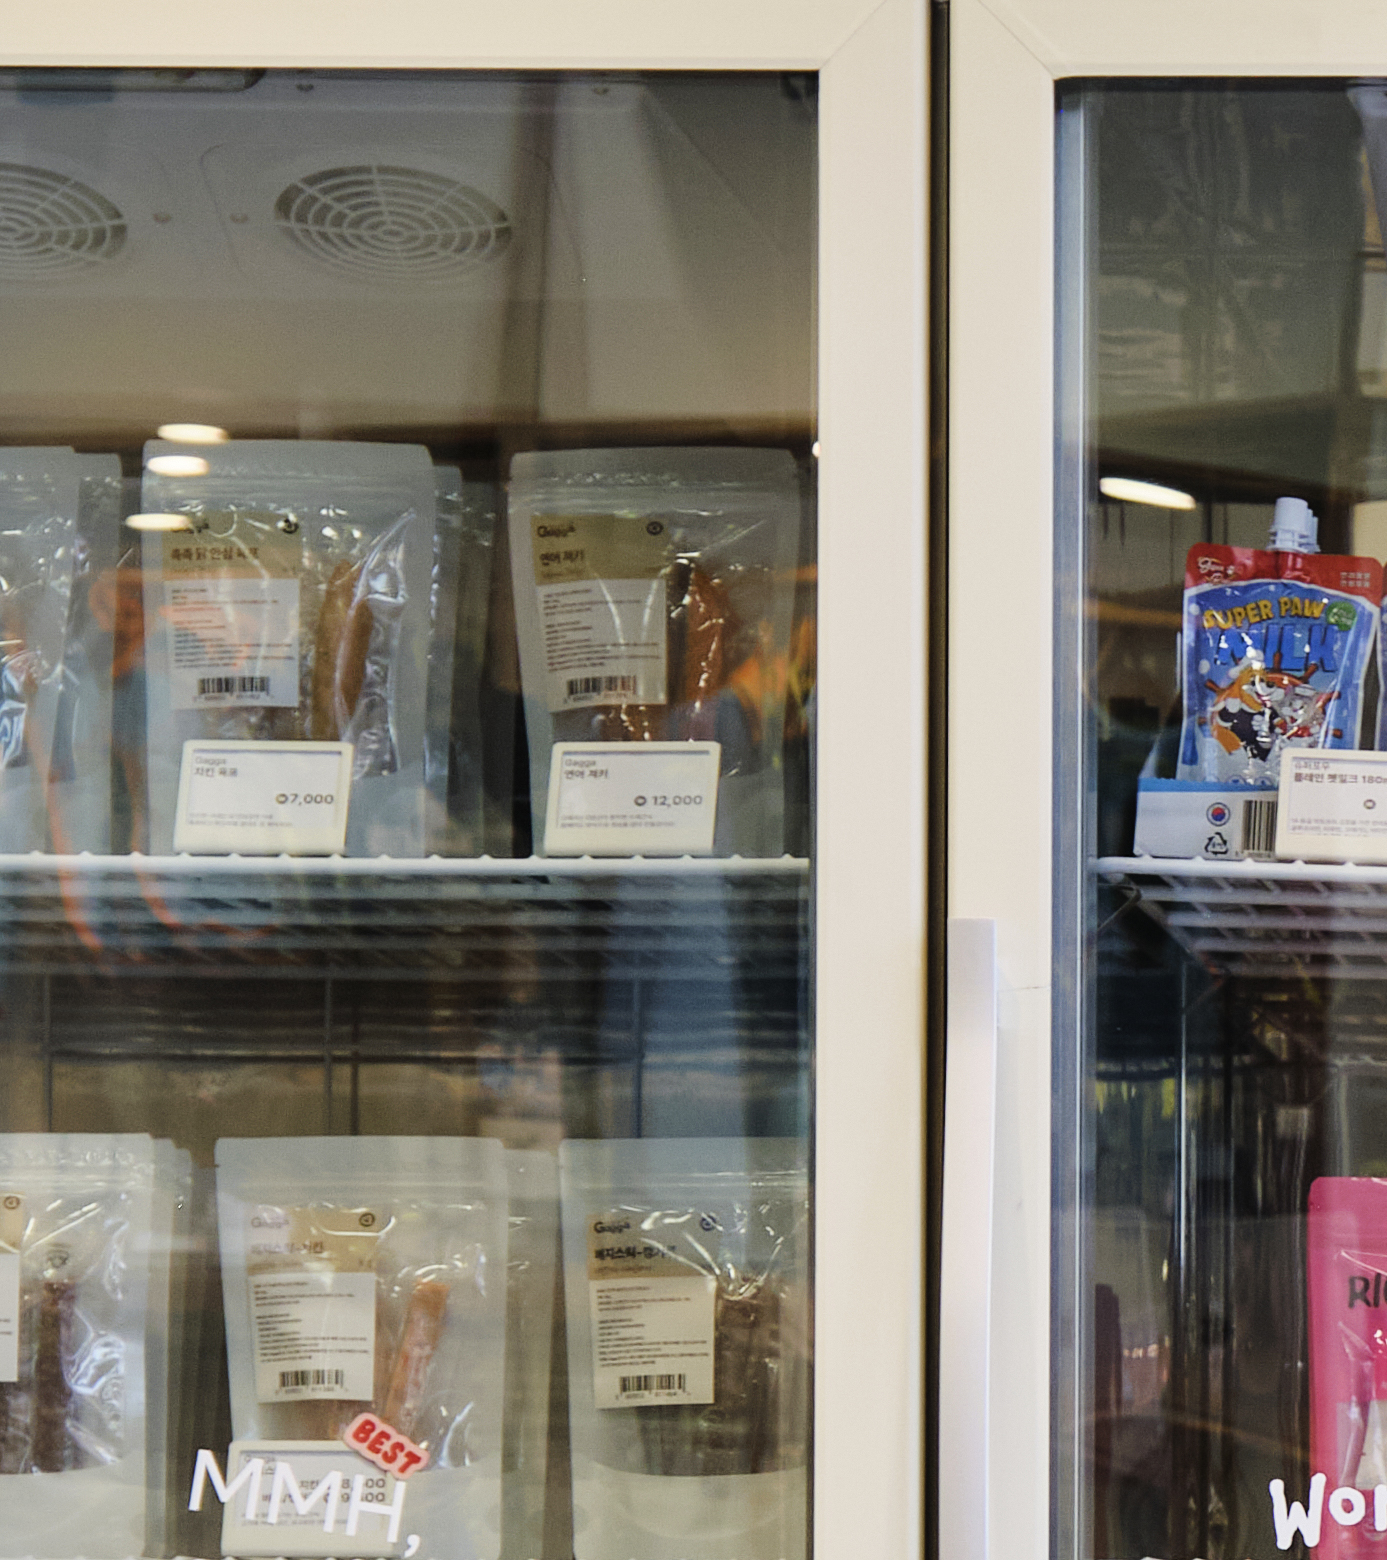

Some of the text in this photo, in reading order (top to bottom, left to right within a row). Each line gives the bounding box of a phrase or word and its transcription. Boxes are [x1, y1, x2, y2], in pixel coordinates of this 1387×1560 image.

[1204, 597, 1326, 630] SUPER PAW
[1213, 624, 1337, 672] MILK
[290, 793, 334, 806] 7,000
[652, 795, 703, 808] 12,000
[352, 1418, 421, 1475] BEST
[188, 1449, 421, 1559] MMH,
